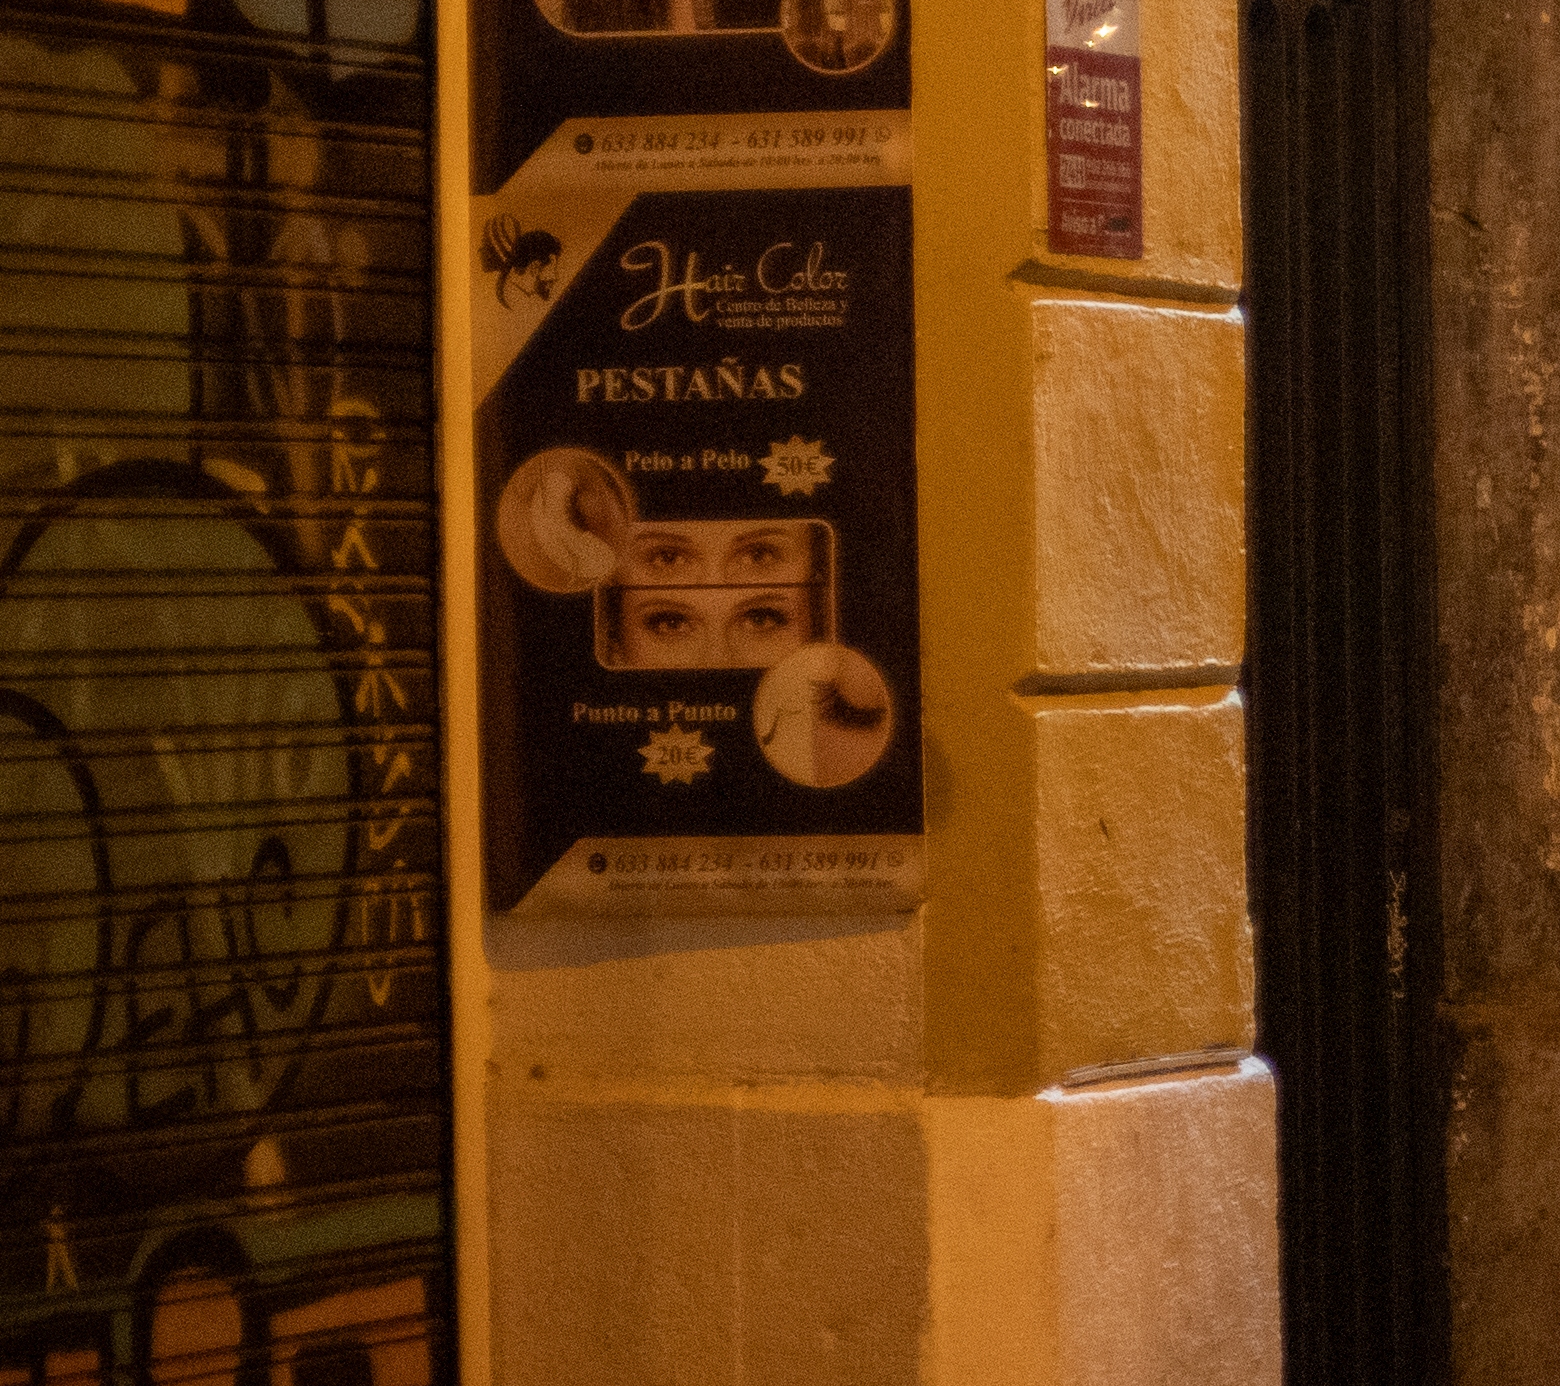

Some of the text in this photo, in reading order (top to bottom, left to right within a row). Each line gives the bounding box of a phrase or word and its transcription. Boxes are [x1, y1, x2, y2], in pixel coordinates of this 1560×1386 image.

[1058, 61, 1131, 113] Alarma
[601, 132, 637, 153] 633
[643, 132, 679, 152] 884
[684, 131, 720, 150] 234
[747, 129, 782, 149] 631
[790, 128, 826, 148] 589
[833, 126, 867, 147] 991
[1058, 116, 1132, 148] conectada
[620, 240, 849, 332] Hair Color
[575, 356, 805, 403] PESTAÑAS
[624, 448, 750, 472] Pelo a Pelo
[572, 700, 738, 724] Punto a Punto
